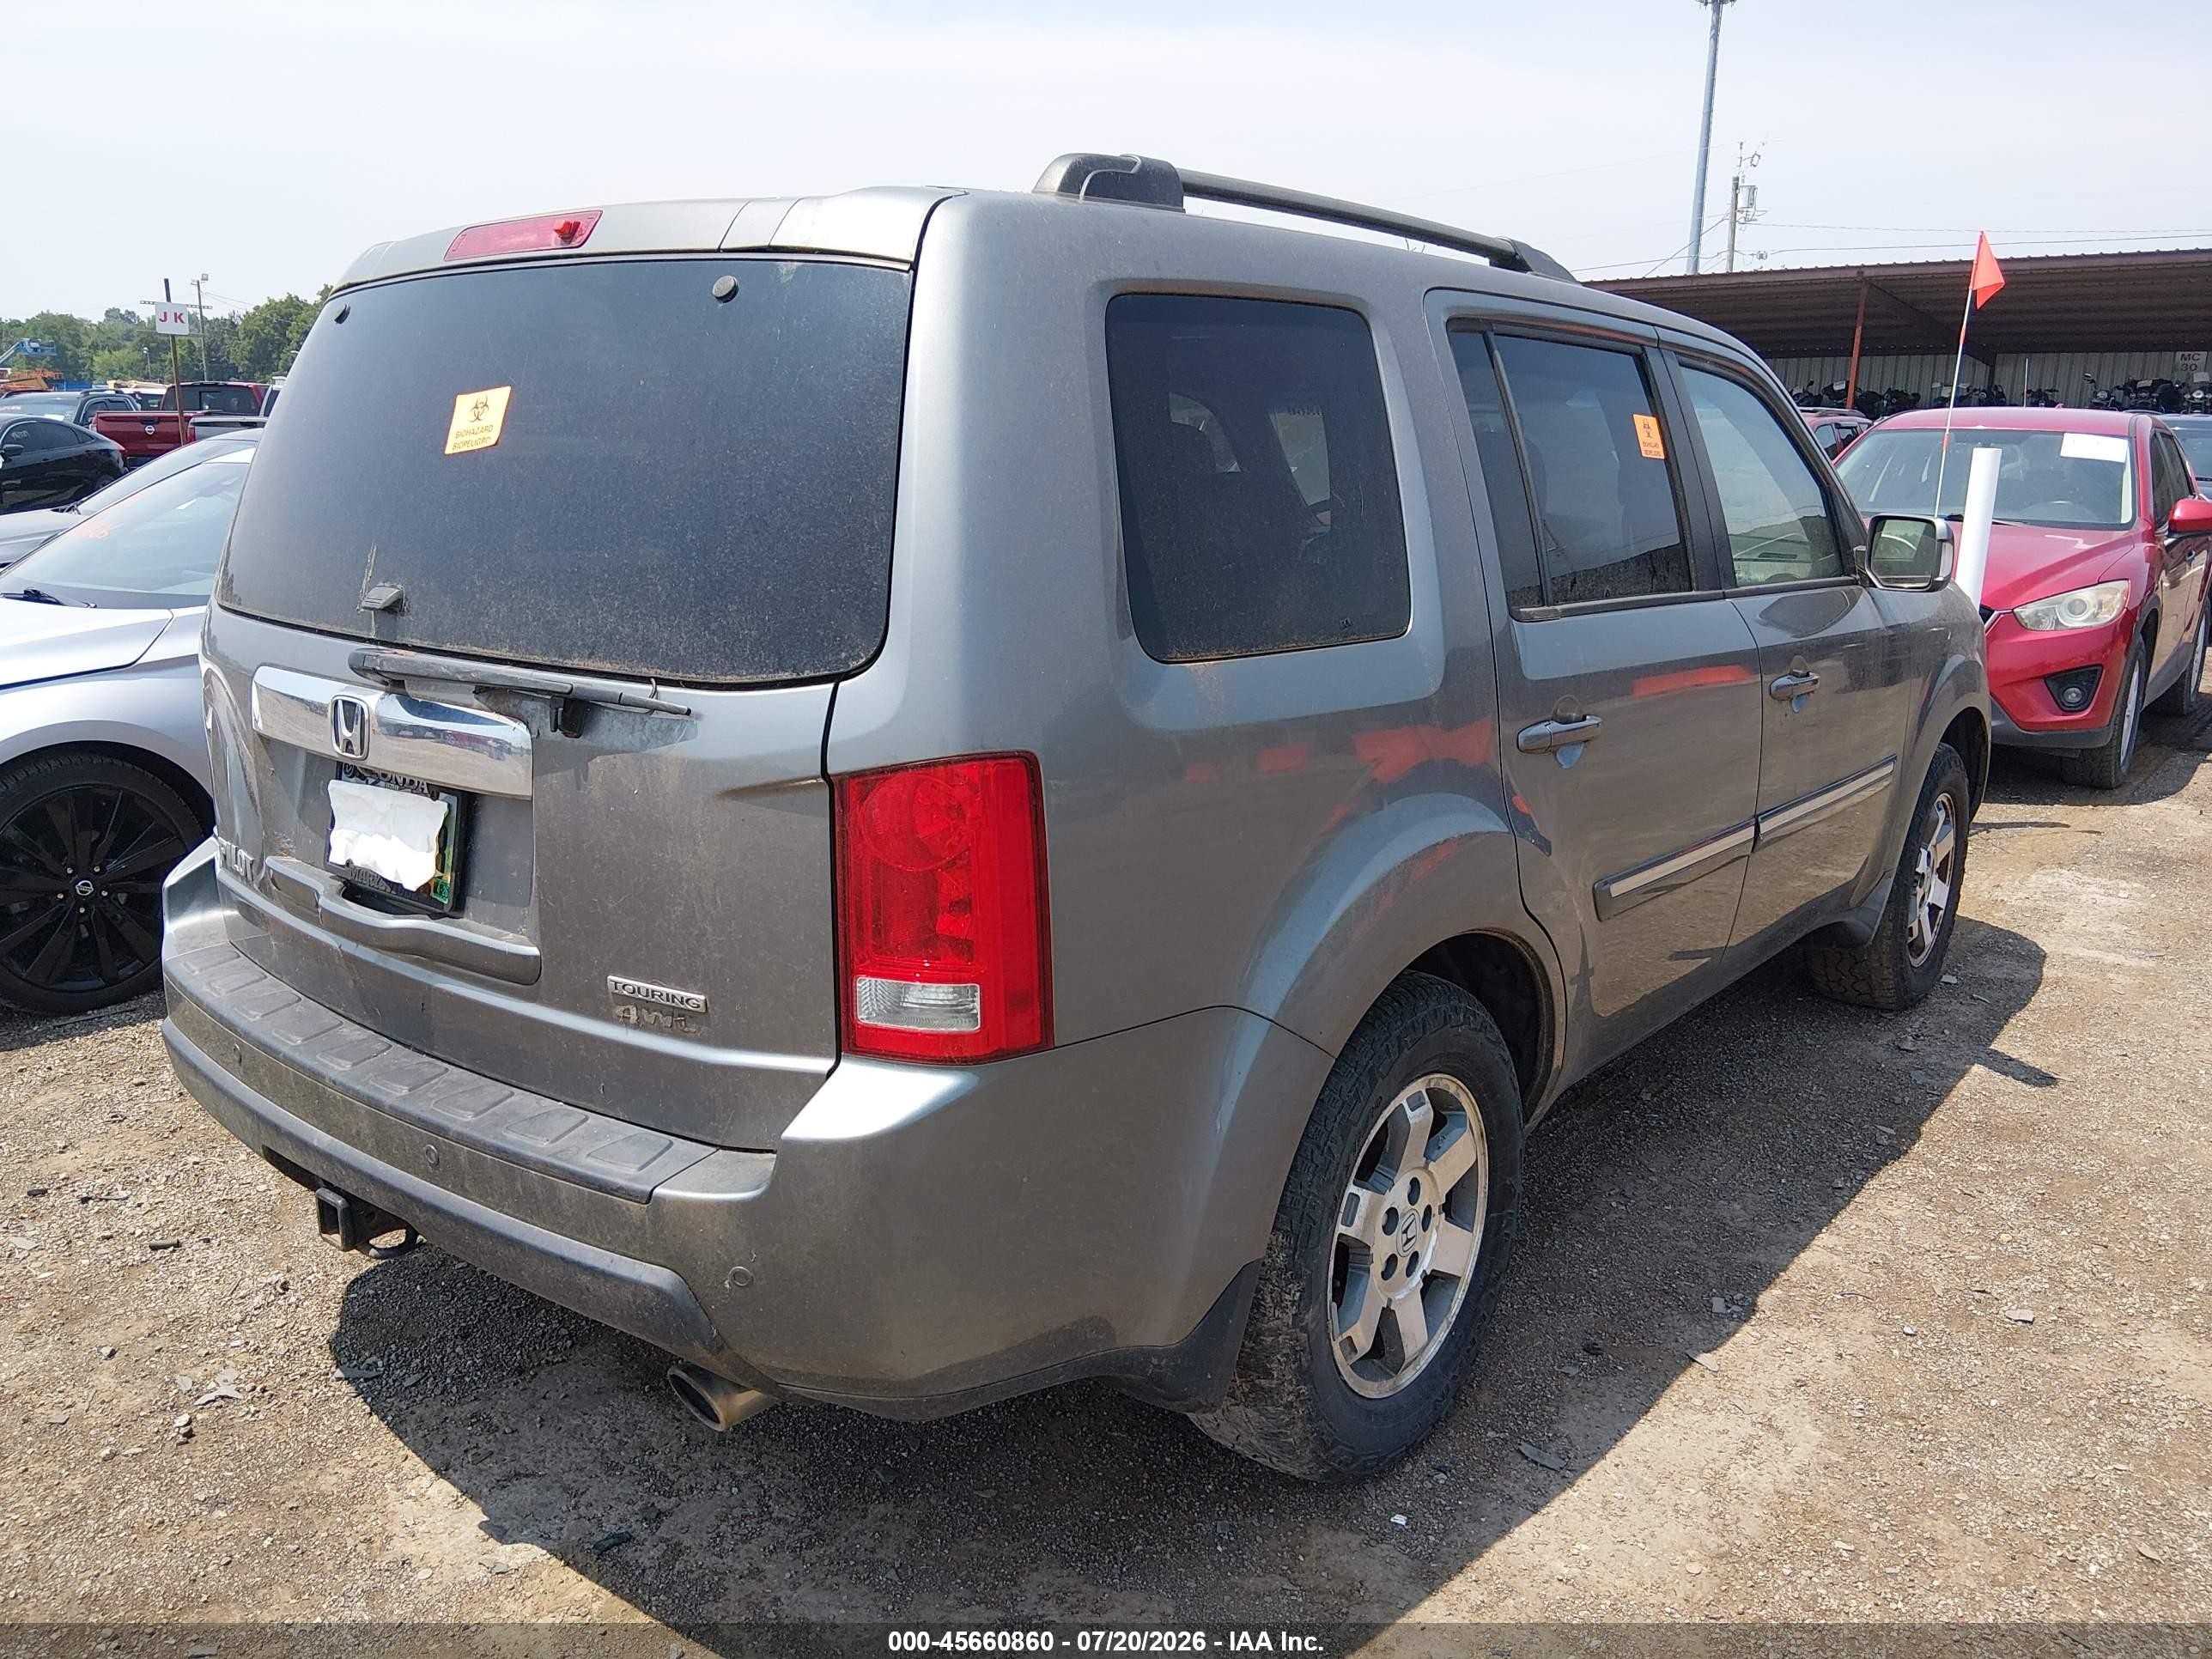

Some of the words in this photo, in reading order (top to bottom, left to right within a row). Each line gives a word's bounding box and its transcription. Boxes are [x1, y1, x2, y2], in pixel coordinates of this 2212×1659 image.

[159, 311, 167, 323] J
[173, 312, 185, 324] K
[2180, 353, 2201, 362] MC
[2181, 363, 2197, 372] 30
[455, 424, 494, 439] BIOHAZARD
[611, 980, 701, 1009] TOURING
